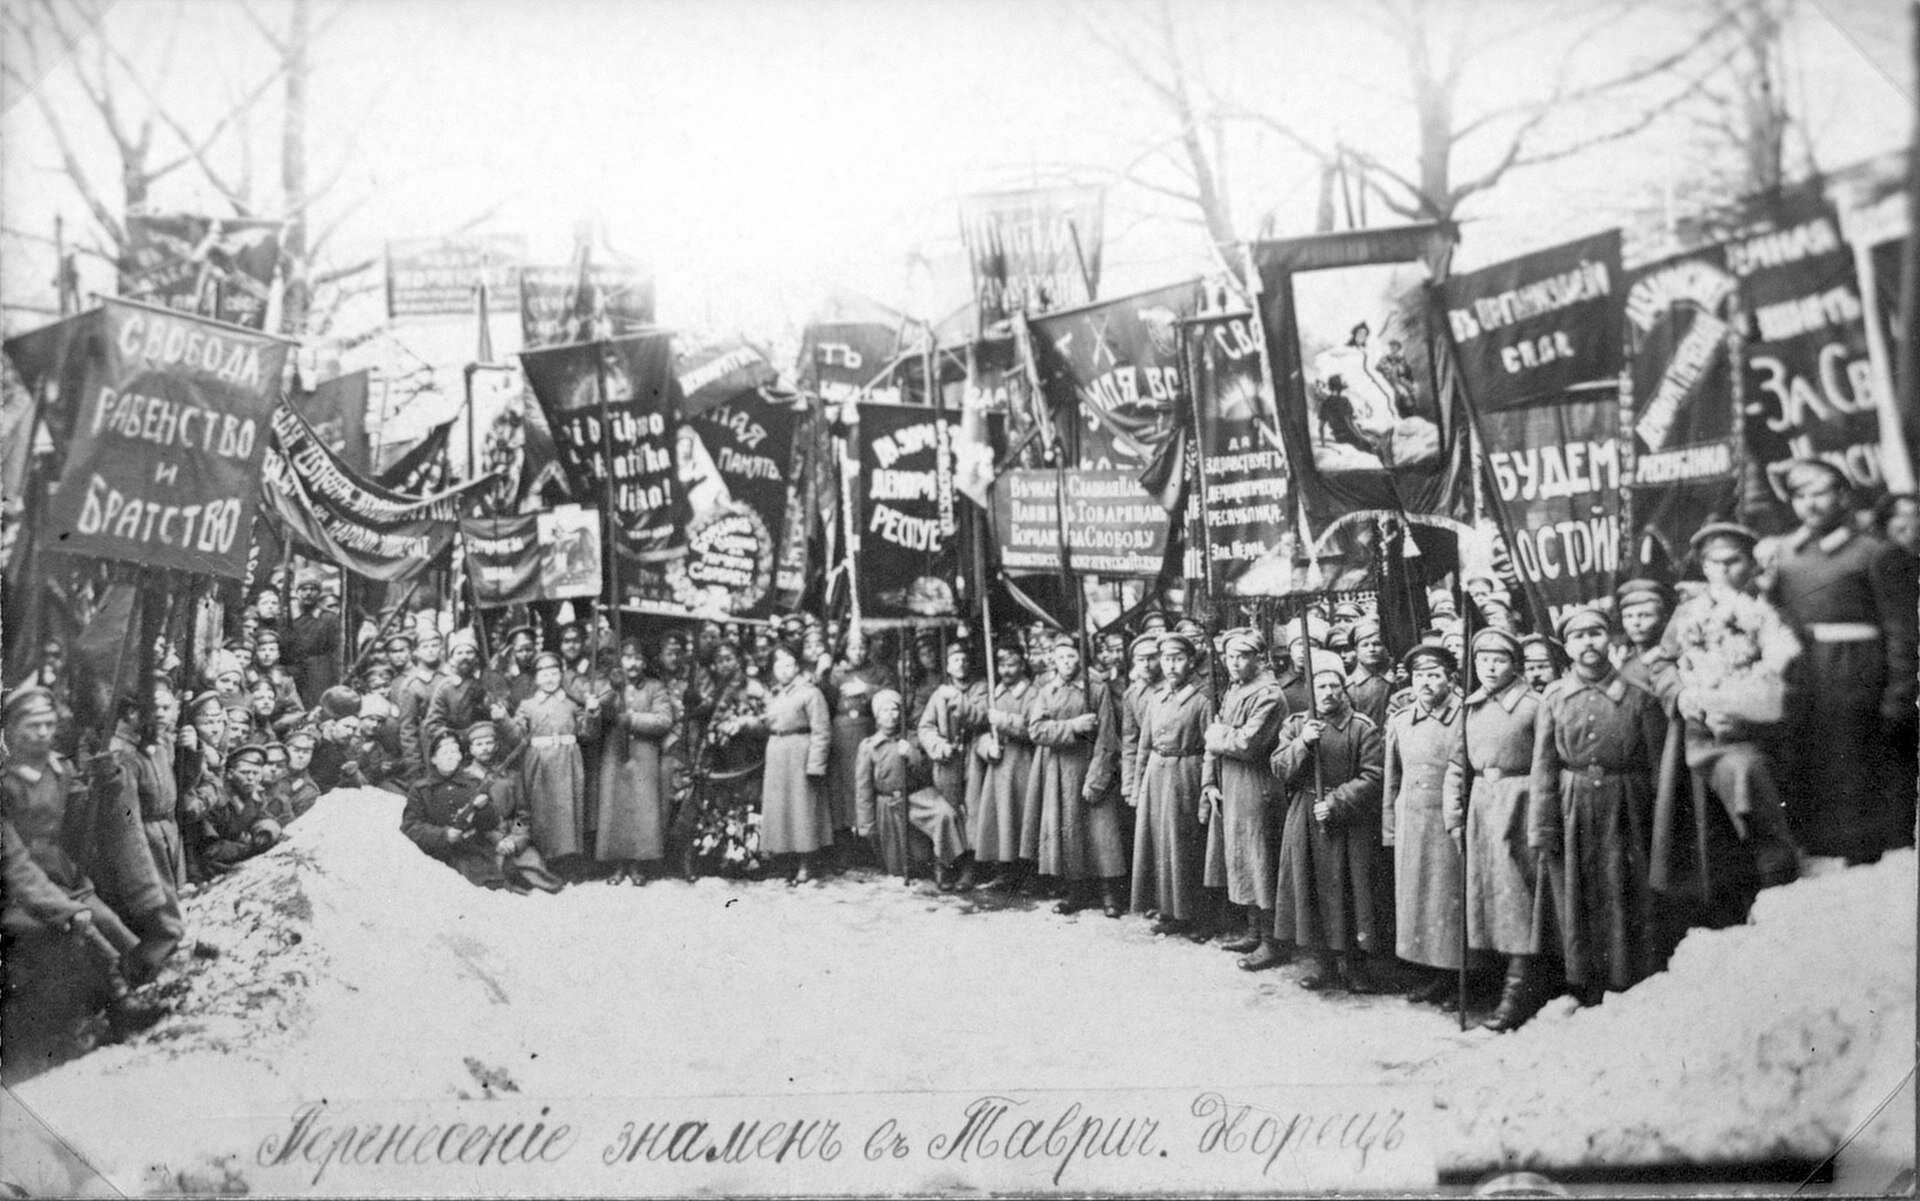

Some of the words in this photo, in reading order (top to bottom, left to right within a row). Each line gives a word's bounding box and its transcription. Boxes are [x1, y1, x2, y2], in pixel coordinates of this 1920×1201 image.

[118, 319, 261, 387] СВОБОДА
[1489, 437, 1619, 502] БУДЕМ
[77, 473, 241, 554] БРАТСТВО
